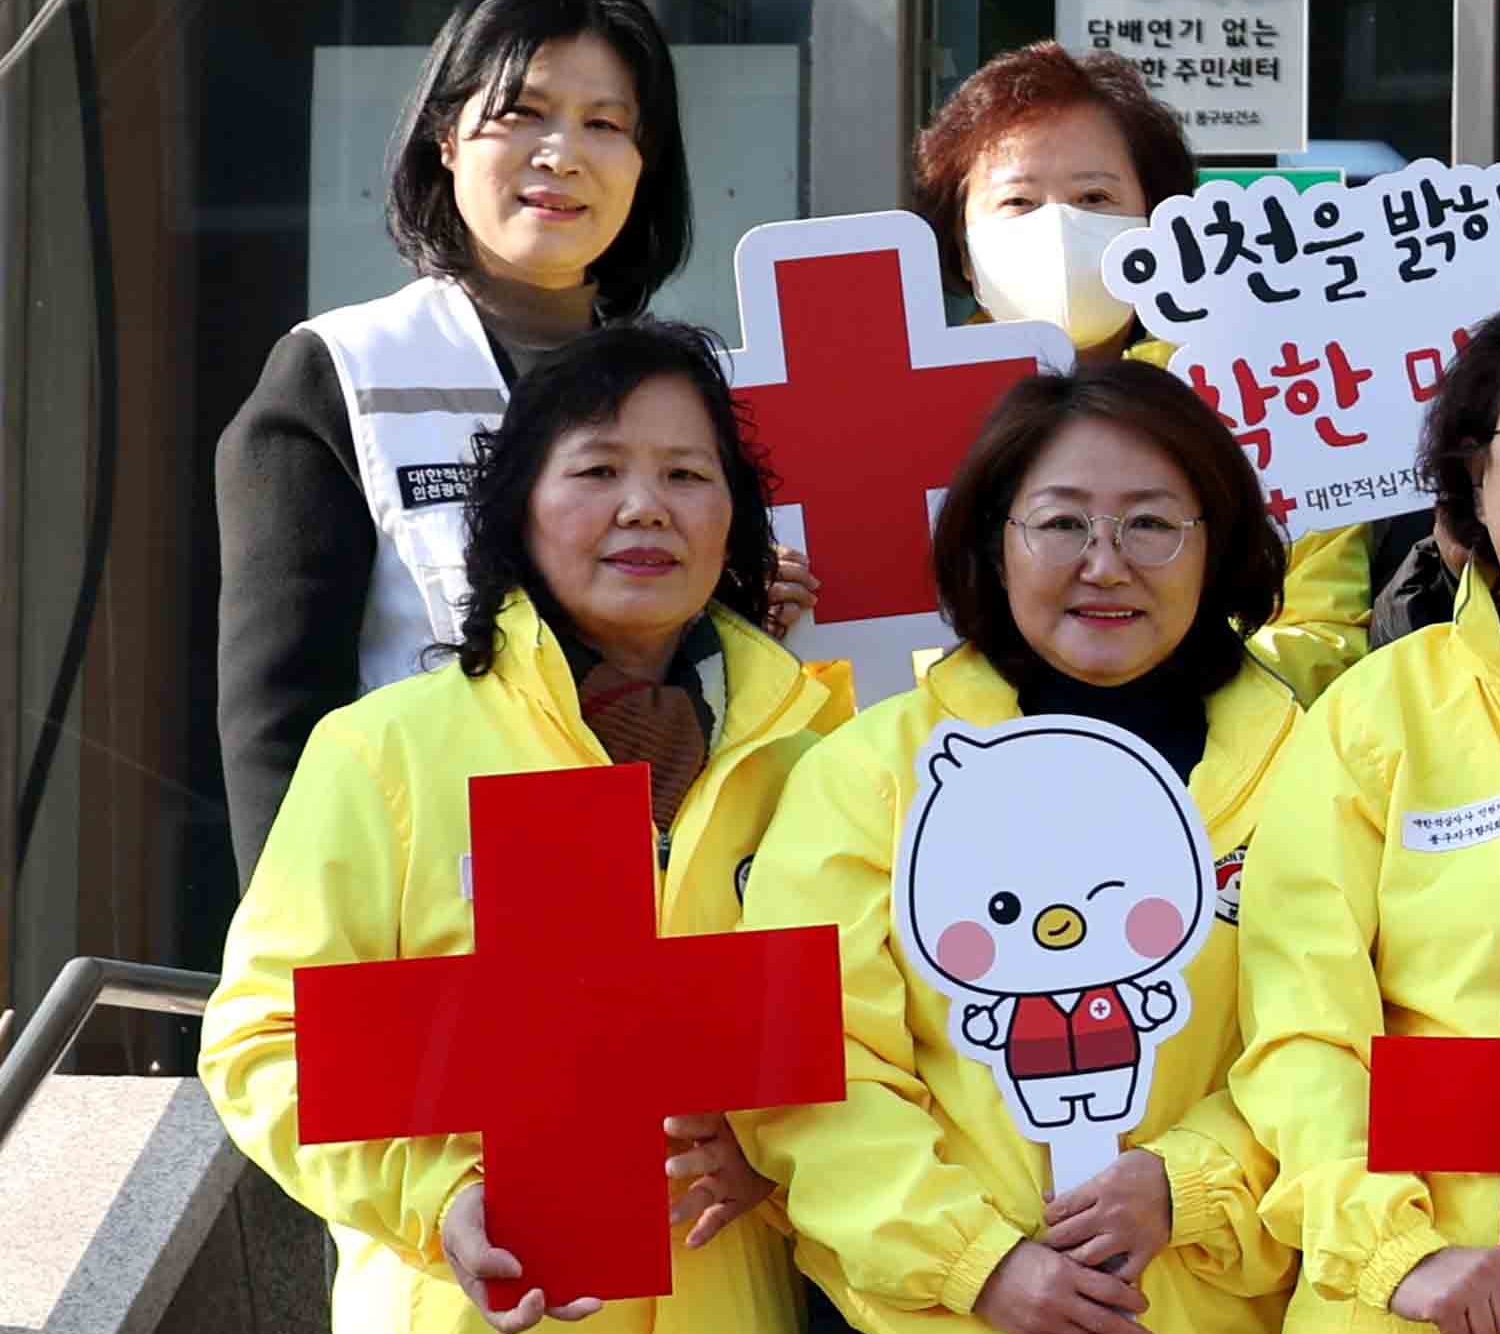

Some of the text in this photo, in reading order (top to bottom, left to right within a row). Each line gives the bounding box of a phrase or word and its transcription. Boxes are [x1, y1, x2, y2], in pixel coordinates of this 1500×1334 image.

[1087, 18, 1280, 49] 담배연기 없는
[1172, 55, 1280, 87] 주민센터
[1121, 195, 1366, 324] 인천을
[407, 467, 476, 486] 대한적십
